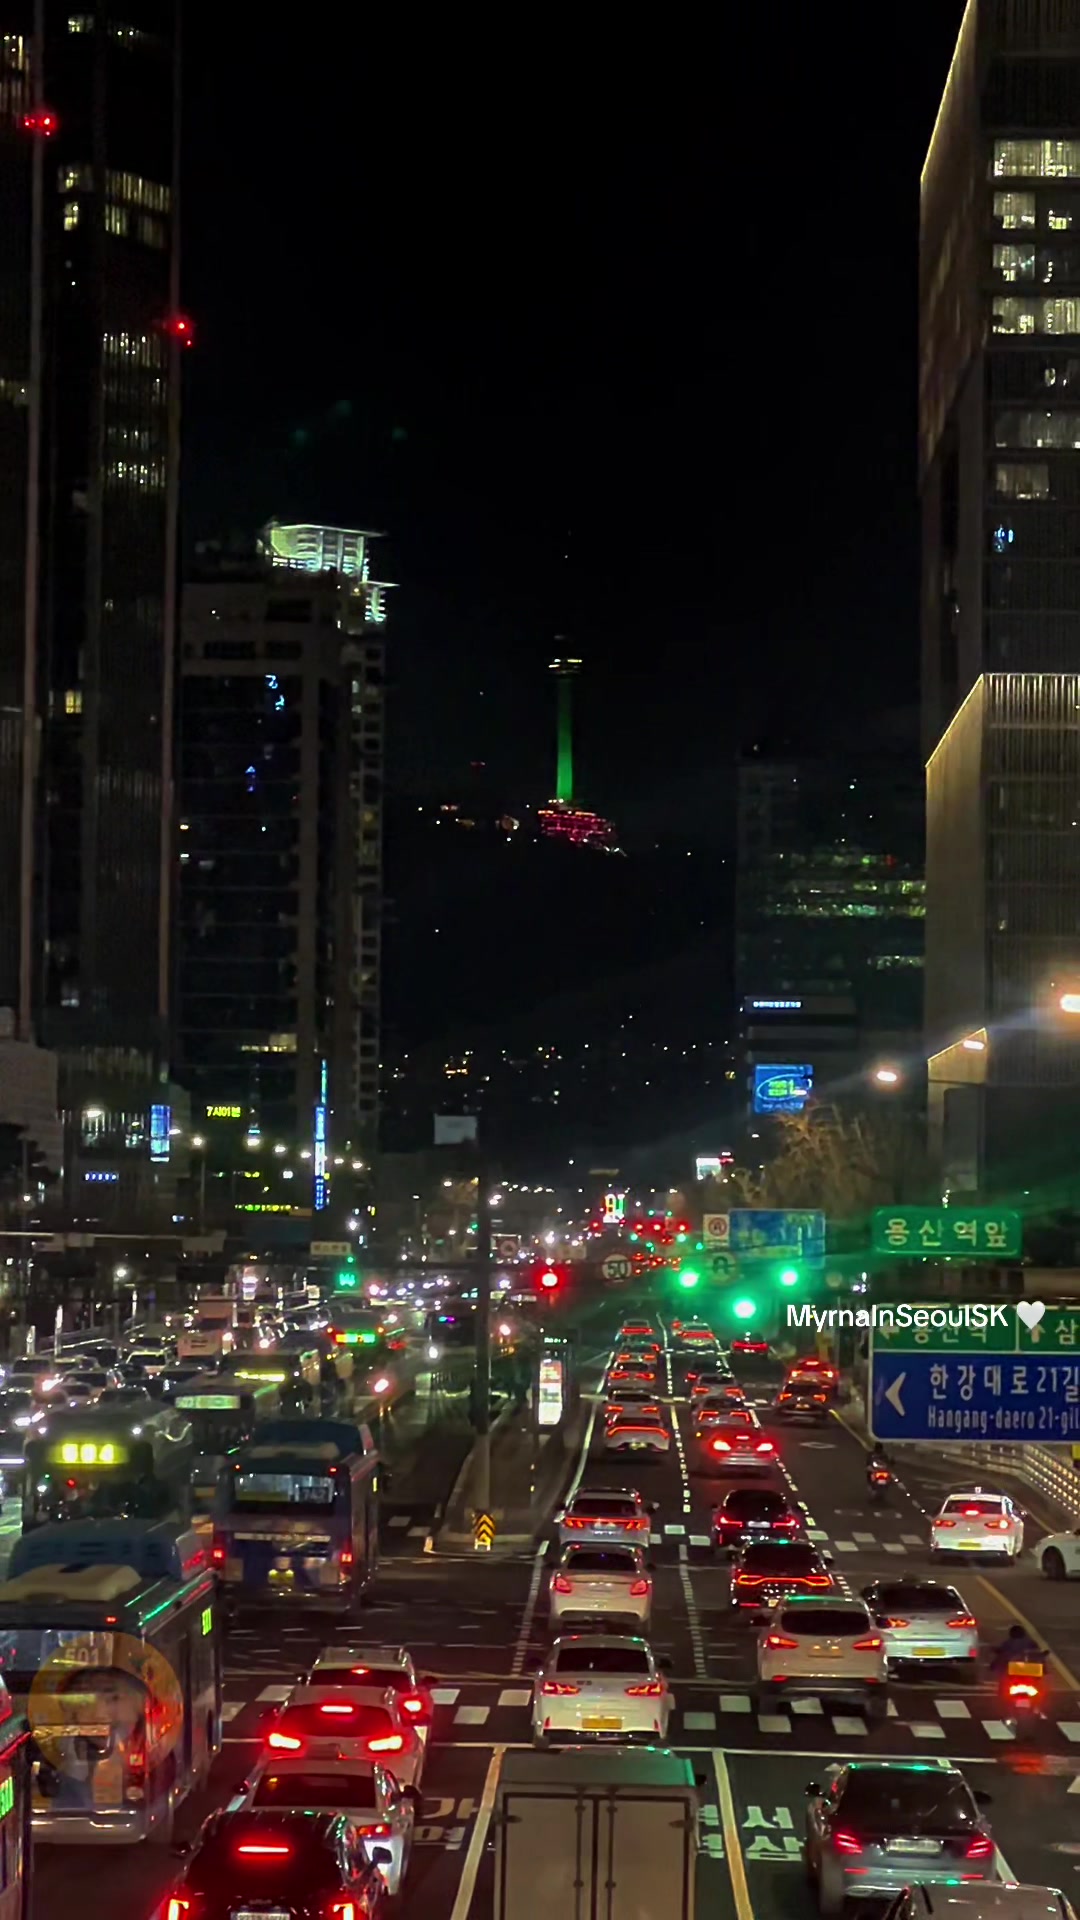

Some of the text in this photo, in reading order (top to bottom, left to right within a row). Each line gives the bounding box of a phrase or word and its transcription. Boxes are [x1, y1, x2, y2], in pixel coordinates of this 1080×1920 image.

[884, 1218, 1008, 1247] 용산역앞
[608, 1261, 628, 1278] 50
[928, 1405, 1035, 1434] Hangang-daero
